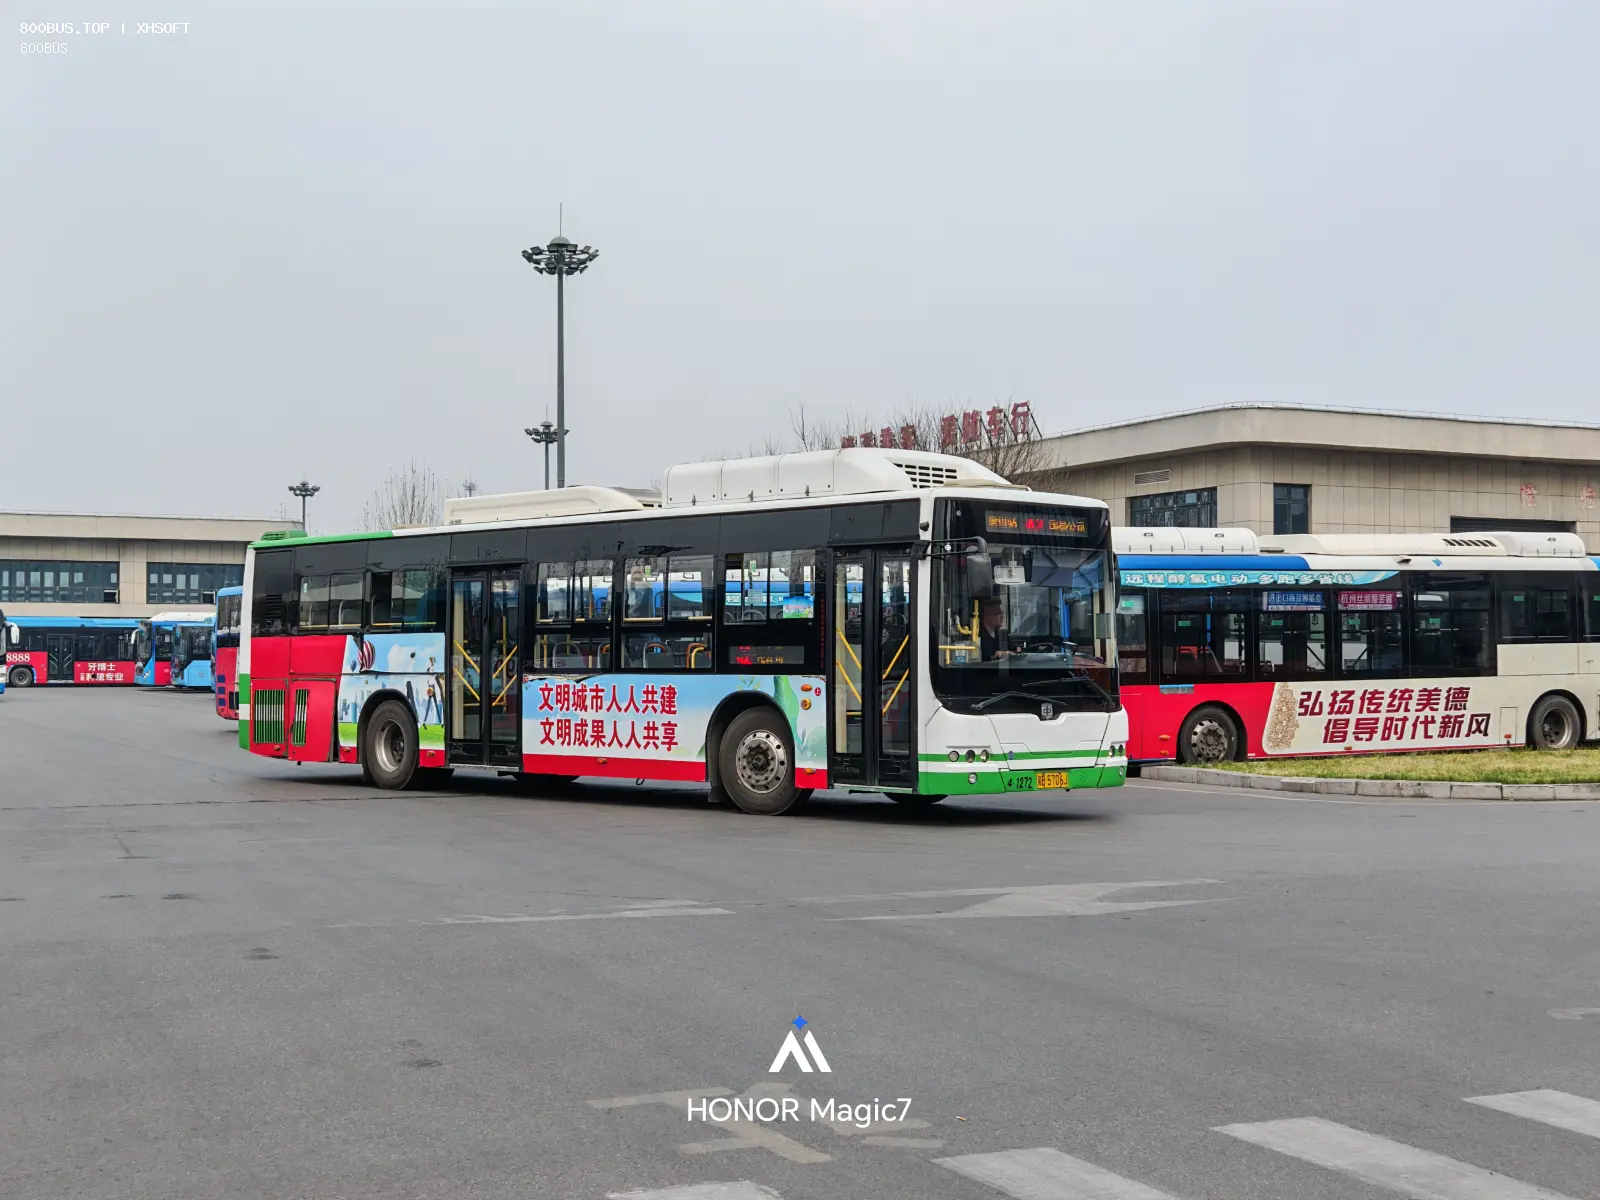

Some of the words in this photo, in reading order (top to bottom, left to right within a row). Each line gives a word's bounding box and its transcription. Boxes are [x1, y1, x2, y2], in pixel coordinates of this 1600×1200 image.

[538, 683, 678, 715] 文明城市人人共建
[1298, 686, 1471, 716] 弘扬传统美德
[539, 717, 679, 752] 文明成果人人共享
[1322, 713, 1491, 744] 倡导时代新风
